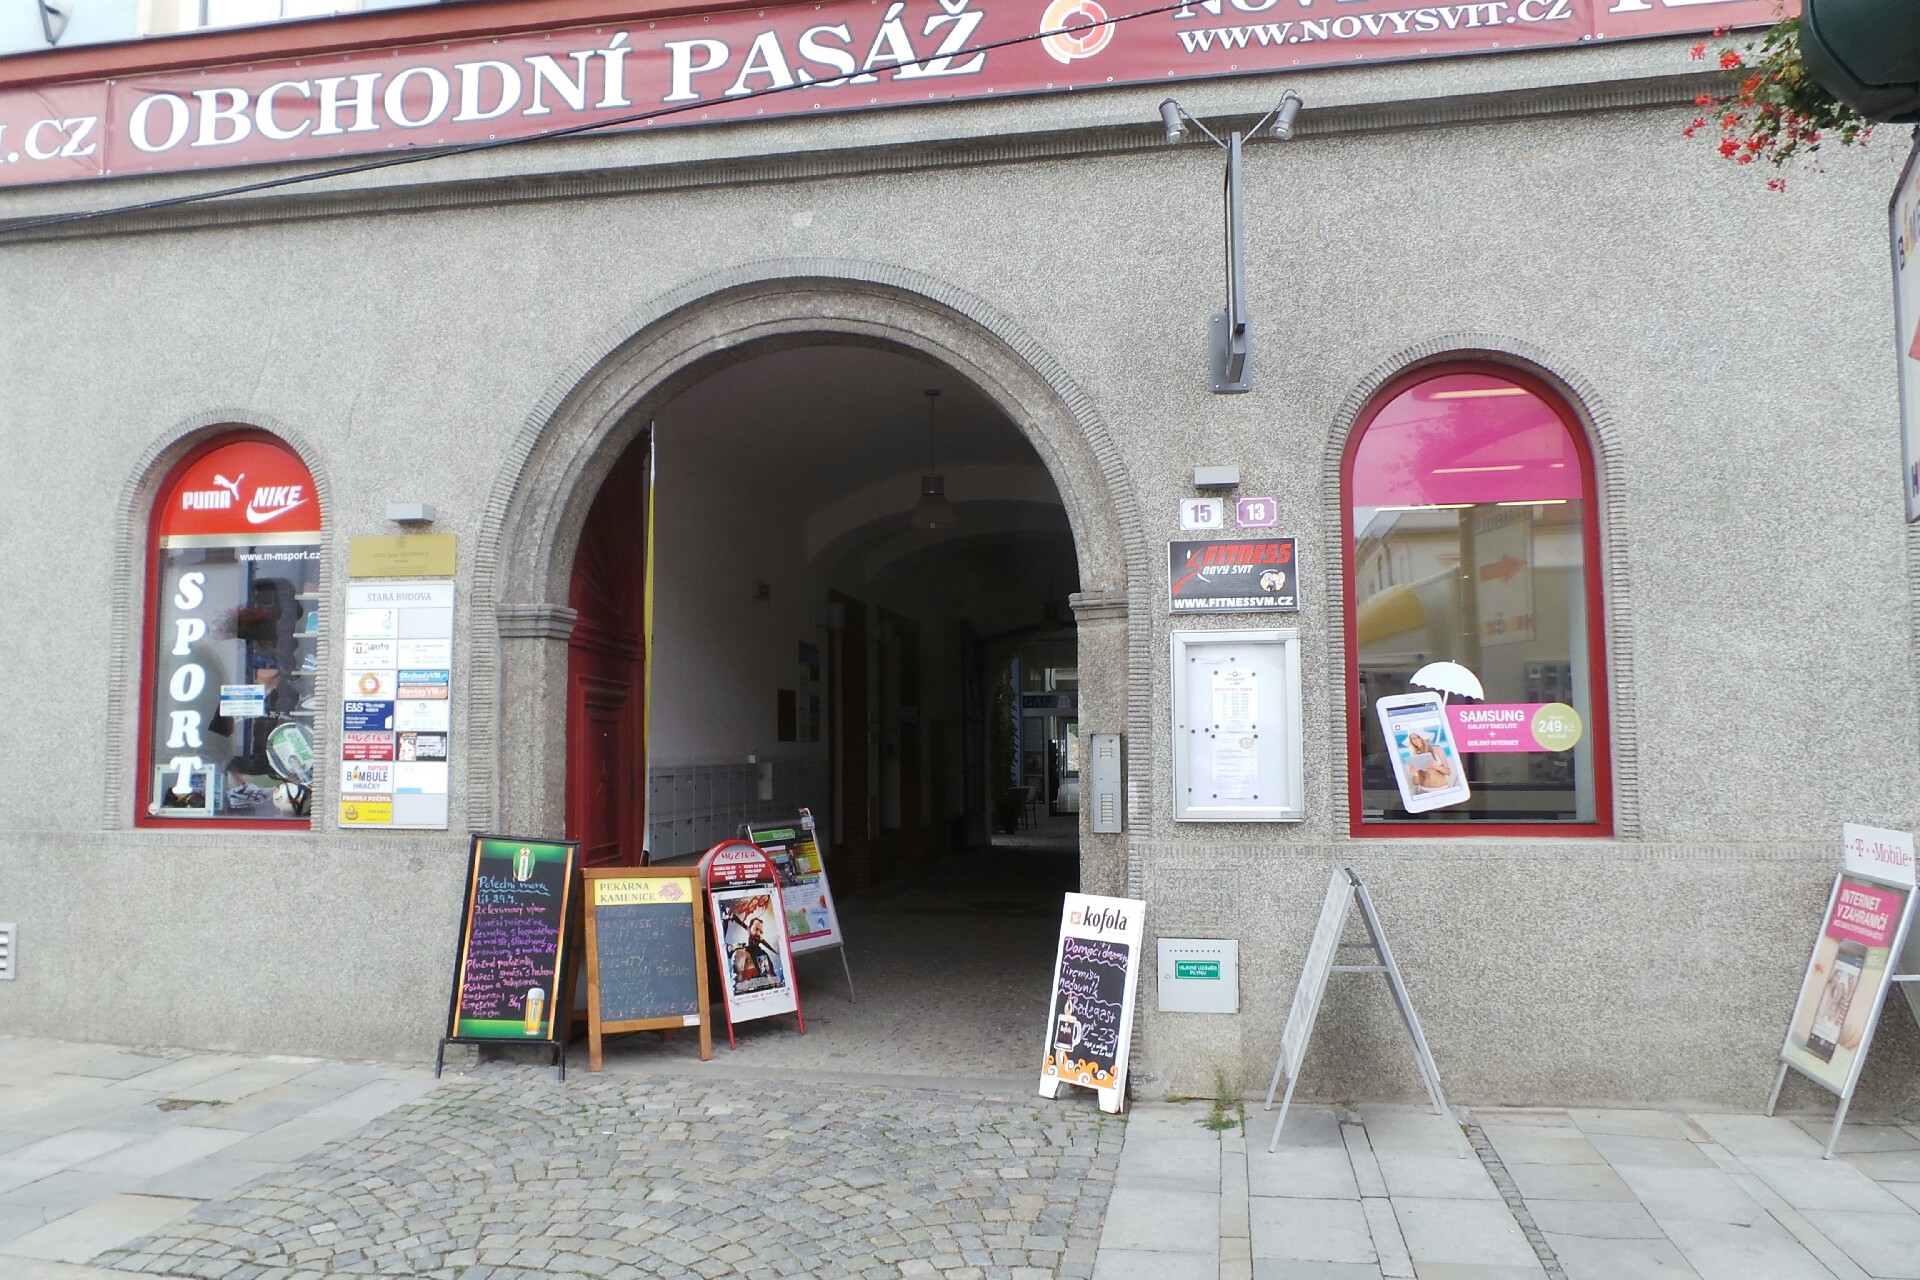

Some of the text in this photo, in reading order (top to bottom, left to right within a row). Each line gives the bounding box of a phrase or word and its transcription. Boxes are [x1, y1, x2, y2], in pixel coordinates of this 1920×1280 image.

[1177, 0, 1572, 54] WWW.NOVYSVIT.CZ
[128, 0, 986, 153] OBCHODNÍ PASÁŽ
[0, 115, 98, 164] .CZ
[182, 490, 231, 511] PUMA
[252, 485, 302, 508] NIKE
[1190, 504, 1212, 523] 15
[1246, 503, 1265, 521] 13
[239, 550, 320, 562] www.m-msport.cz
[1202, 543, 1292, 566] FITNESS
[367, 591, 432, 602] STARÁ BUDOVA
[1174, 596, 1294, 609] WWW.FITNESSVM.CZ
[166, 571, 207, 795] SPORT
[345, 702, 364, 713] E&S
[1459, 709, 1525, 723] SAMSUNG
[1538, 720, 1562, 733] 249
[353, 781, 381, 790] HRAČKY
[599, 881, 650, 891] PEKÁRNA
[600, 892, 656, 903] KAMENICE
[1840, 888, 1882, 912] INTERNET
[1082, 905, 1128, 934] kofola
[1842, 905, 1889, 931] ZAHRANIČÍ
[1065, 938, 1102, 958] Domácí
